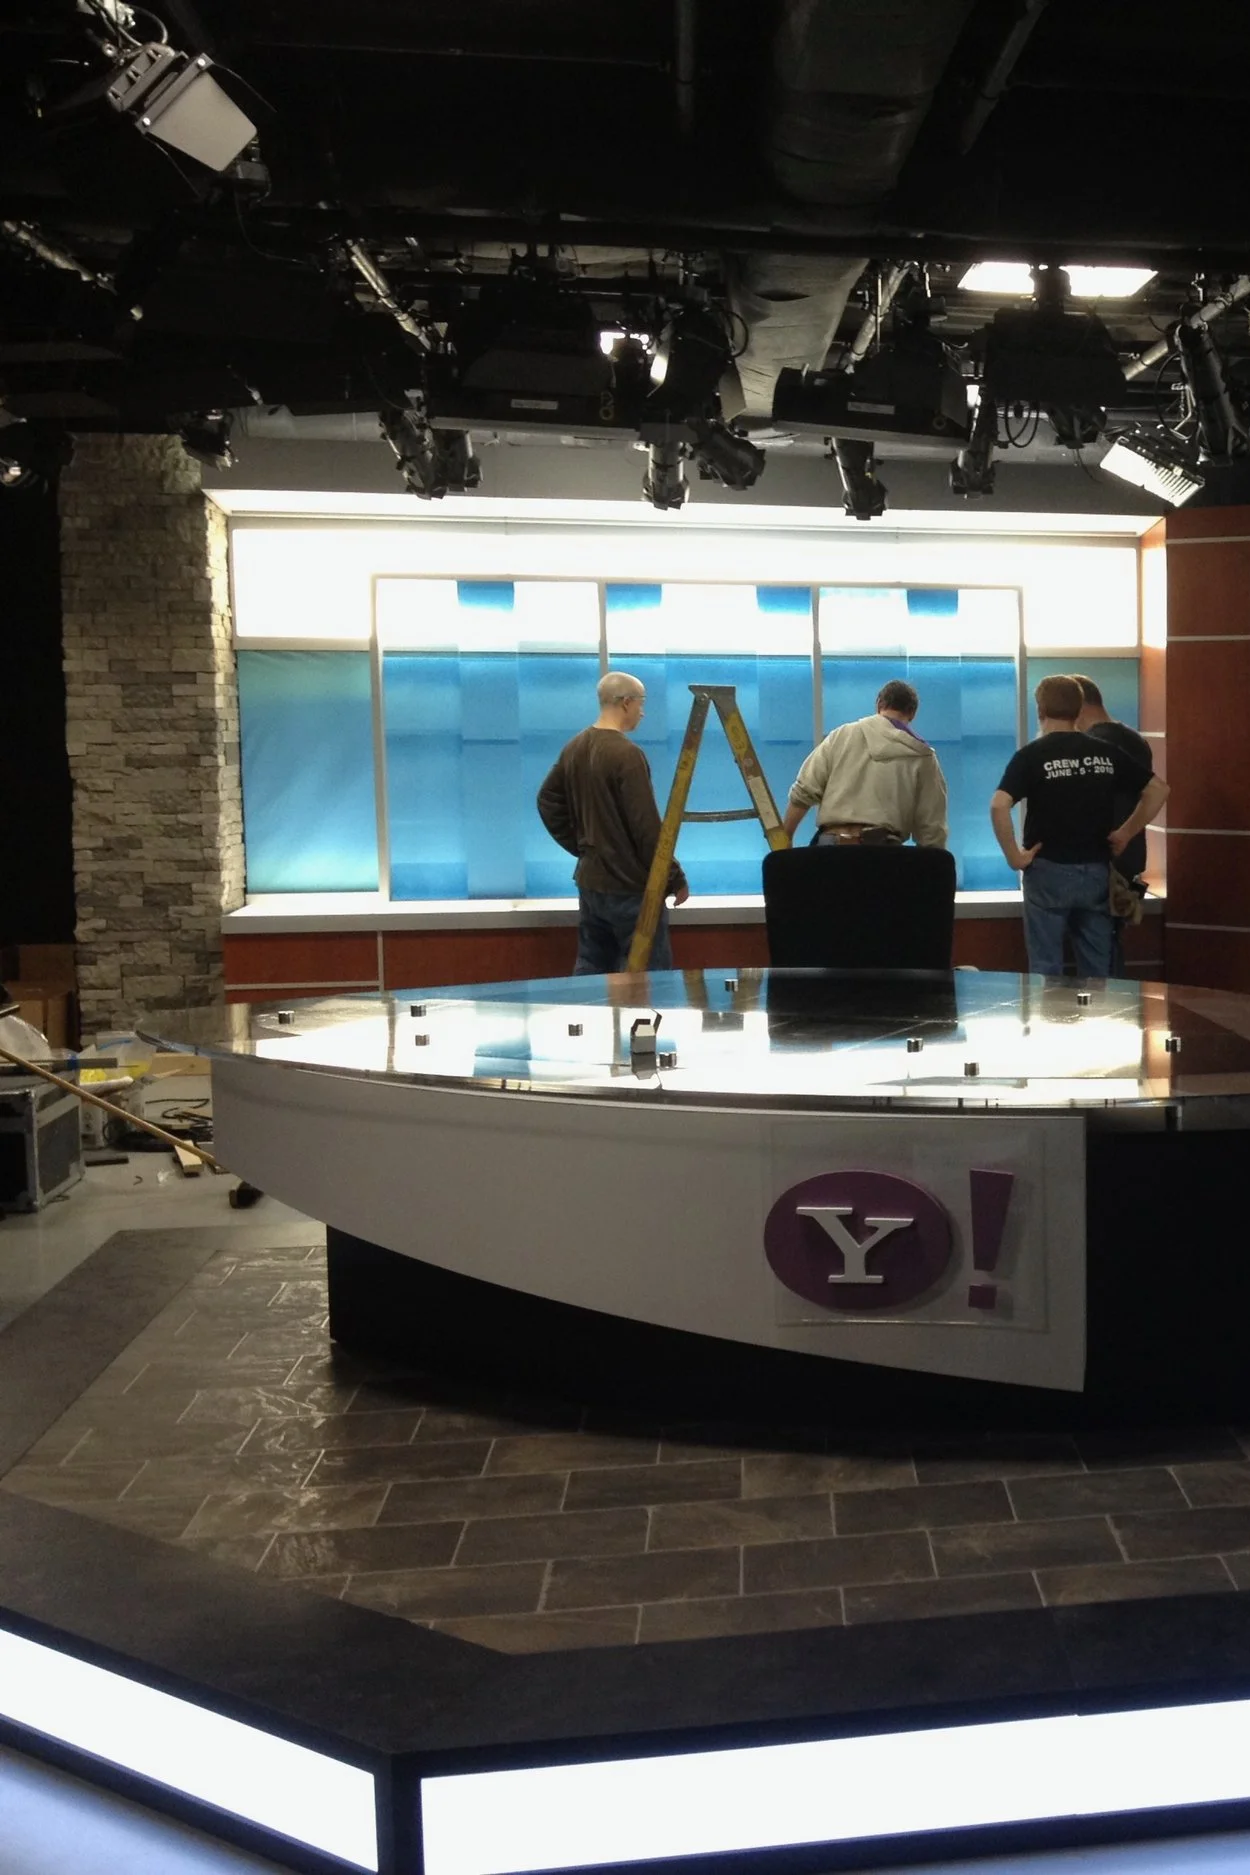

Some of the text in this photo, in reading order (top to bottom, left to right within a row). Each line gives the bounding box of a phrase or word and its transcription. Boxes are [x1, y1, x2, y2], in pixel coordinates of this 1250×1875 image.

[1043, 756, 1113, 771] CREW CALL
[1046, 768, 1072, 779] JUNE
